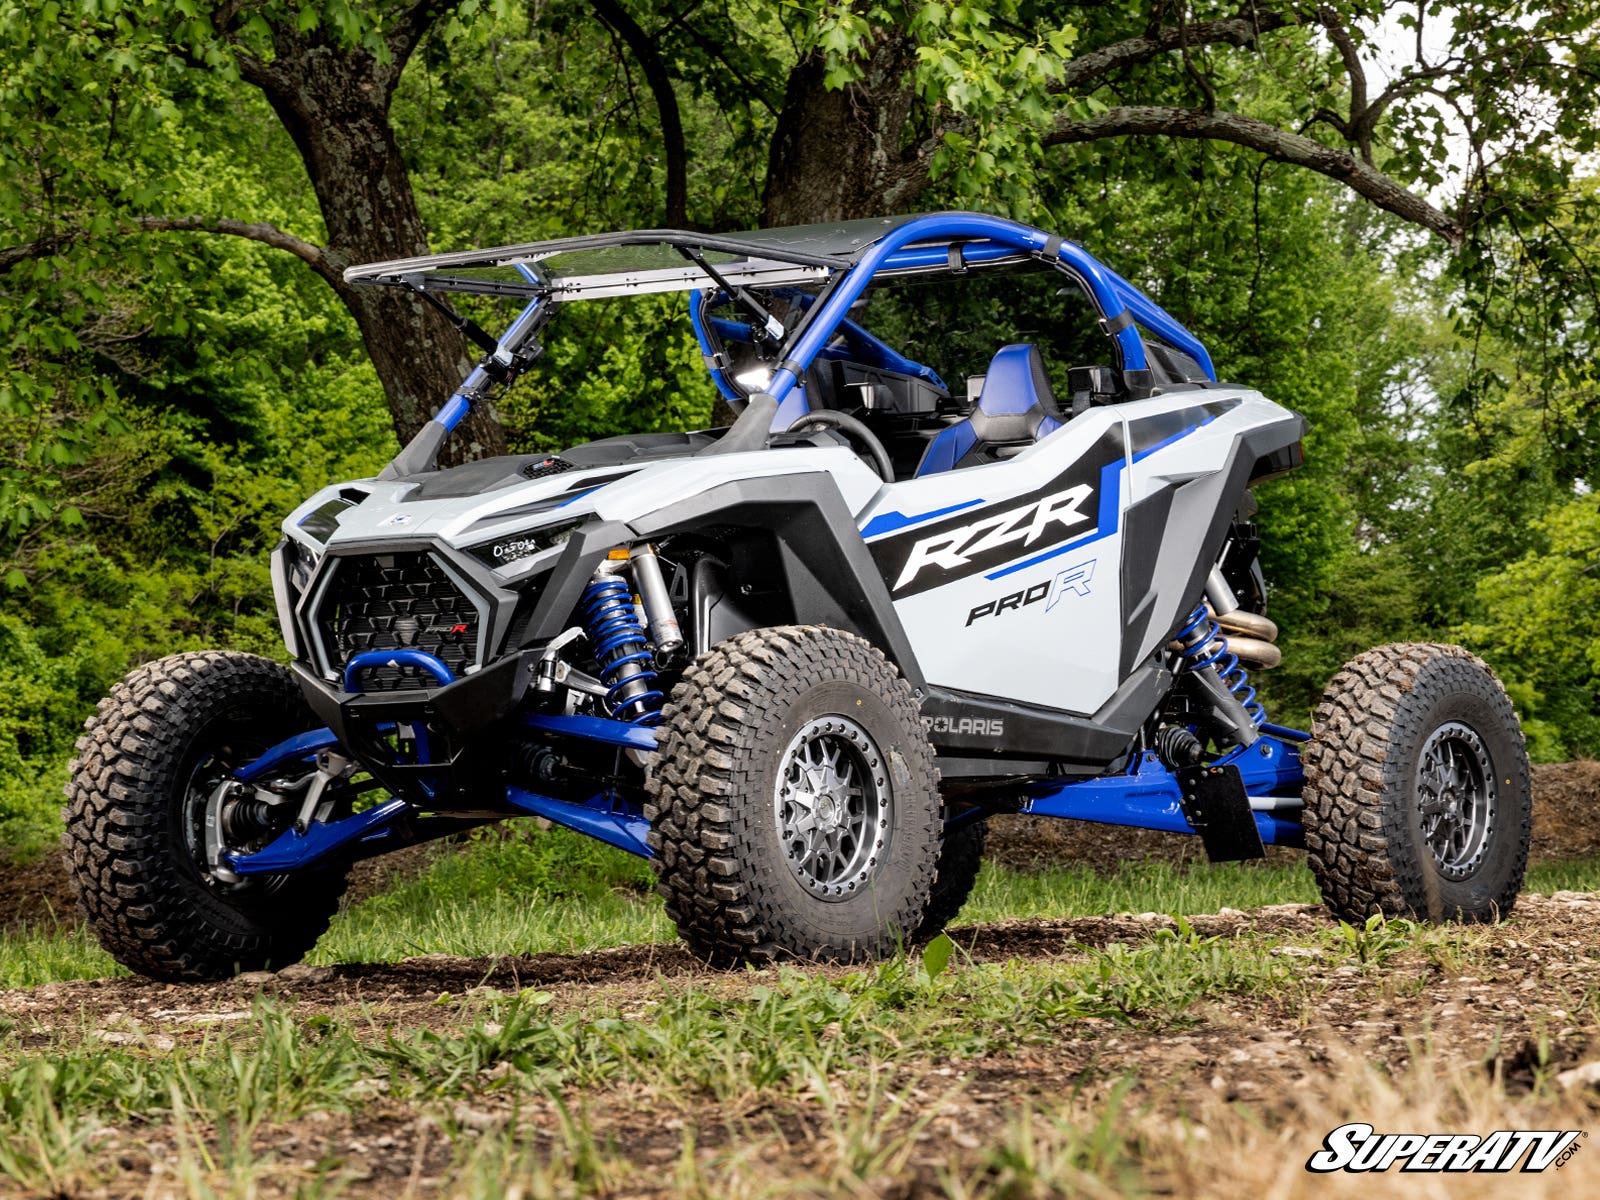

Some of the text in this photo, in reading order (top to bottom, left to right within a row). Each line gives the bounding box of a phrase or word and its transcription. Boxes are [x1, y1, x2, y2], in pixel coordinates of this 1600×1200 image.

[892, 483, 1094, 592] RZR
[965, 580, 1052, 628] PRO
[920, 716, 1004, 736] POLARIS
